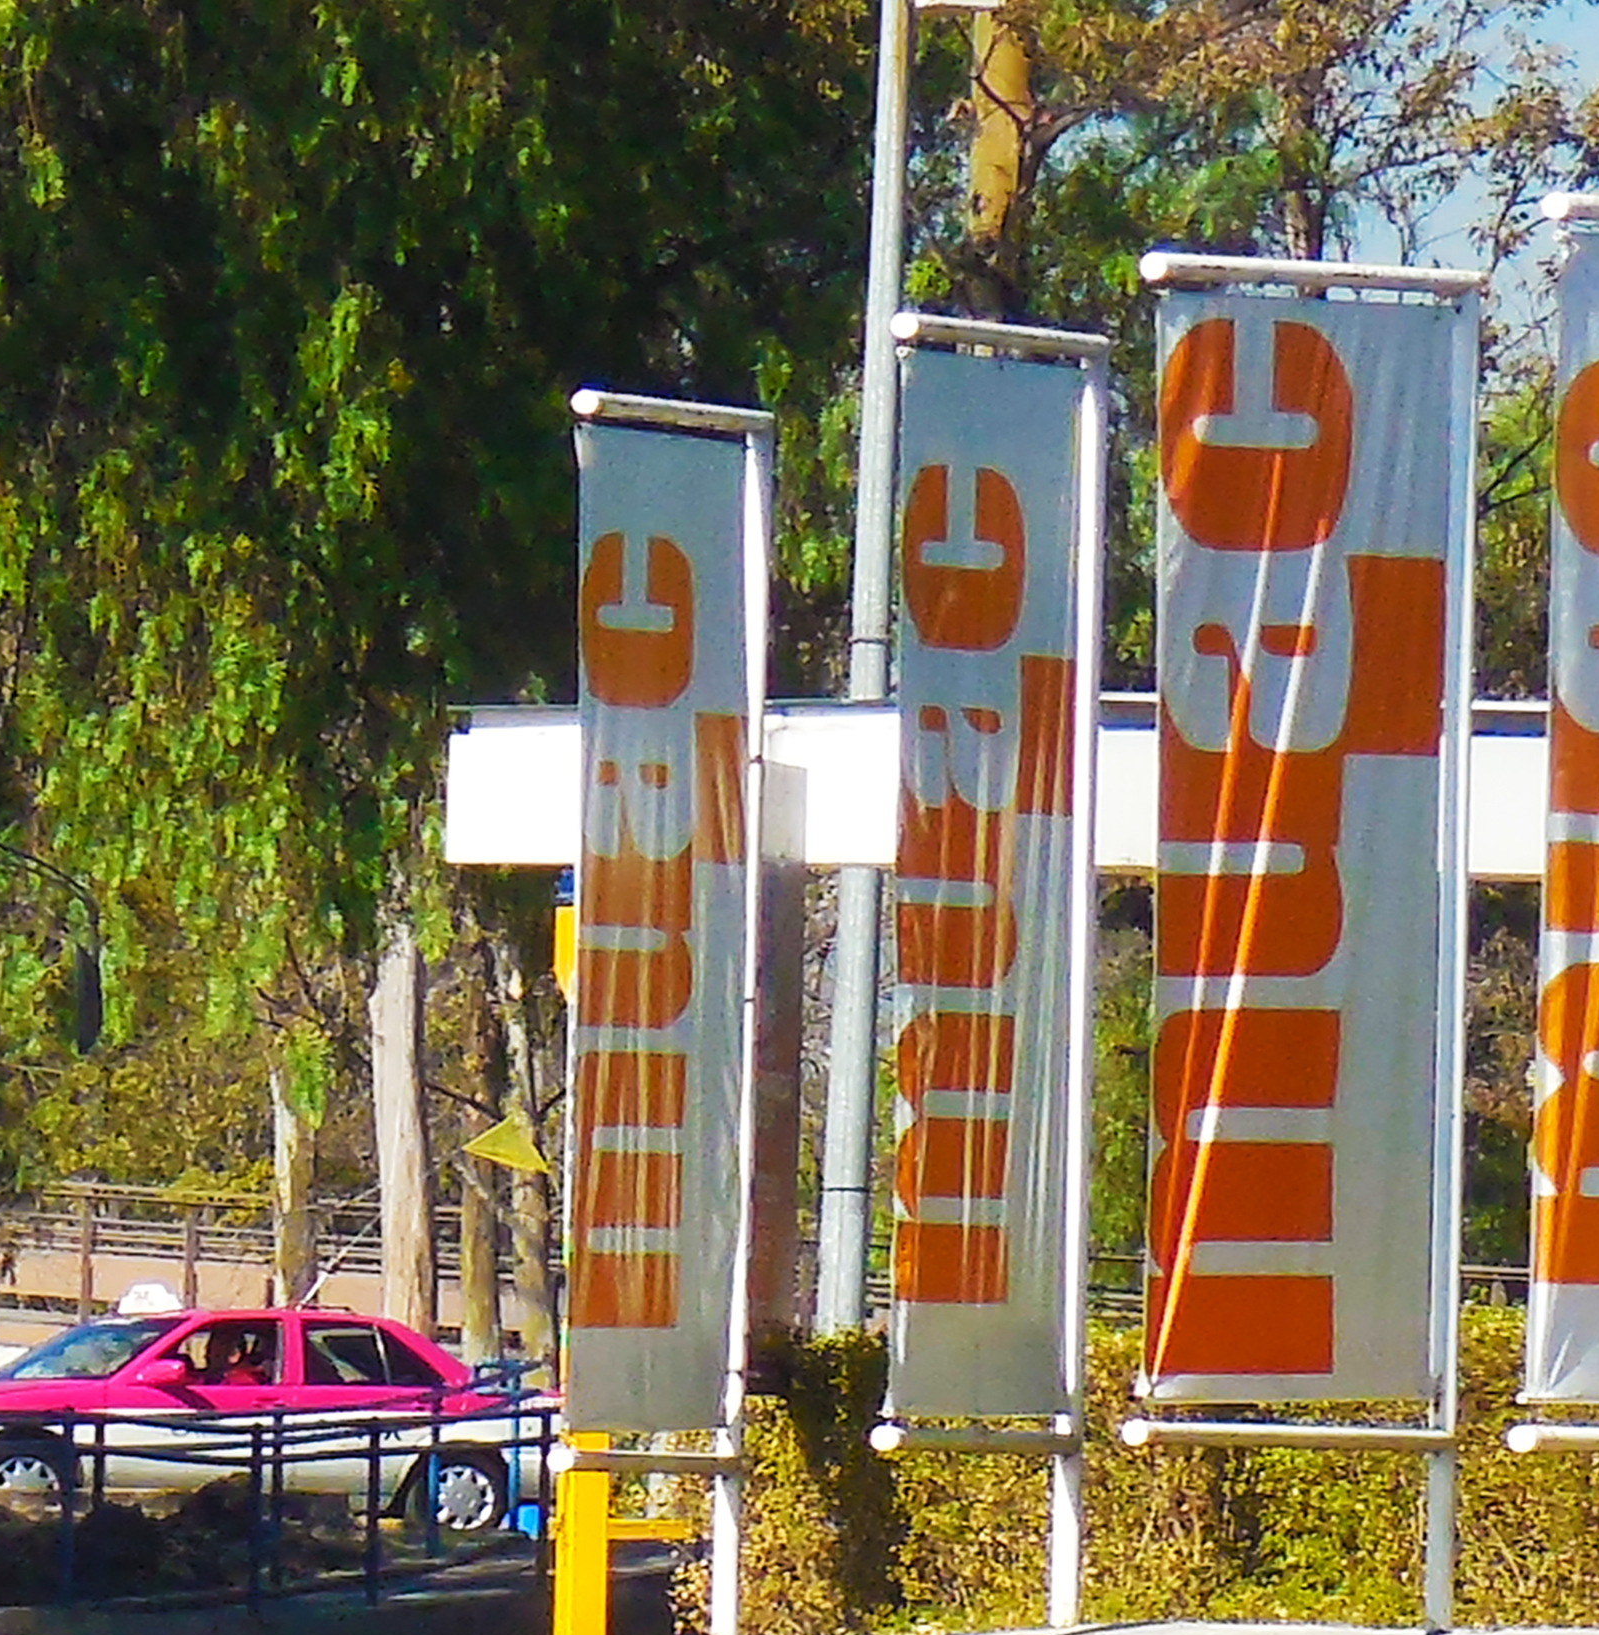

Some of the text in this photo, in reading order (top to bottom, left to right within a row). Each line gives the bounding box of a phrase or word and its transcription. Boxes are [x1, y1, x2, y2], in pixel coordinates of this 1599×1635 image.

[567, 531, 694, 1329] muac
[893, 464, 1025, 1304] muac
[1147, 319, 1353, 1375] muac
